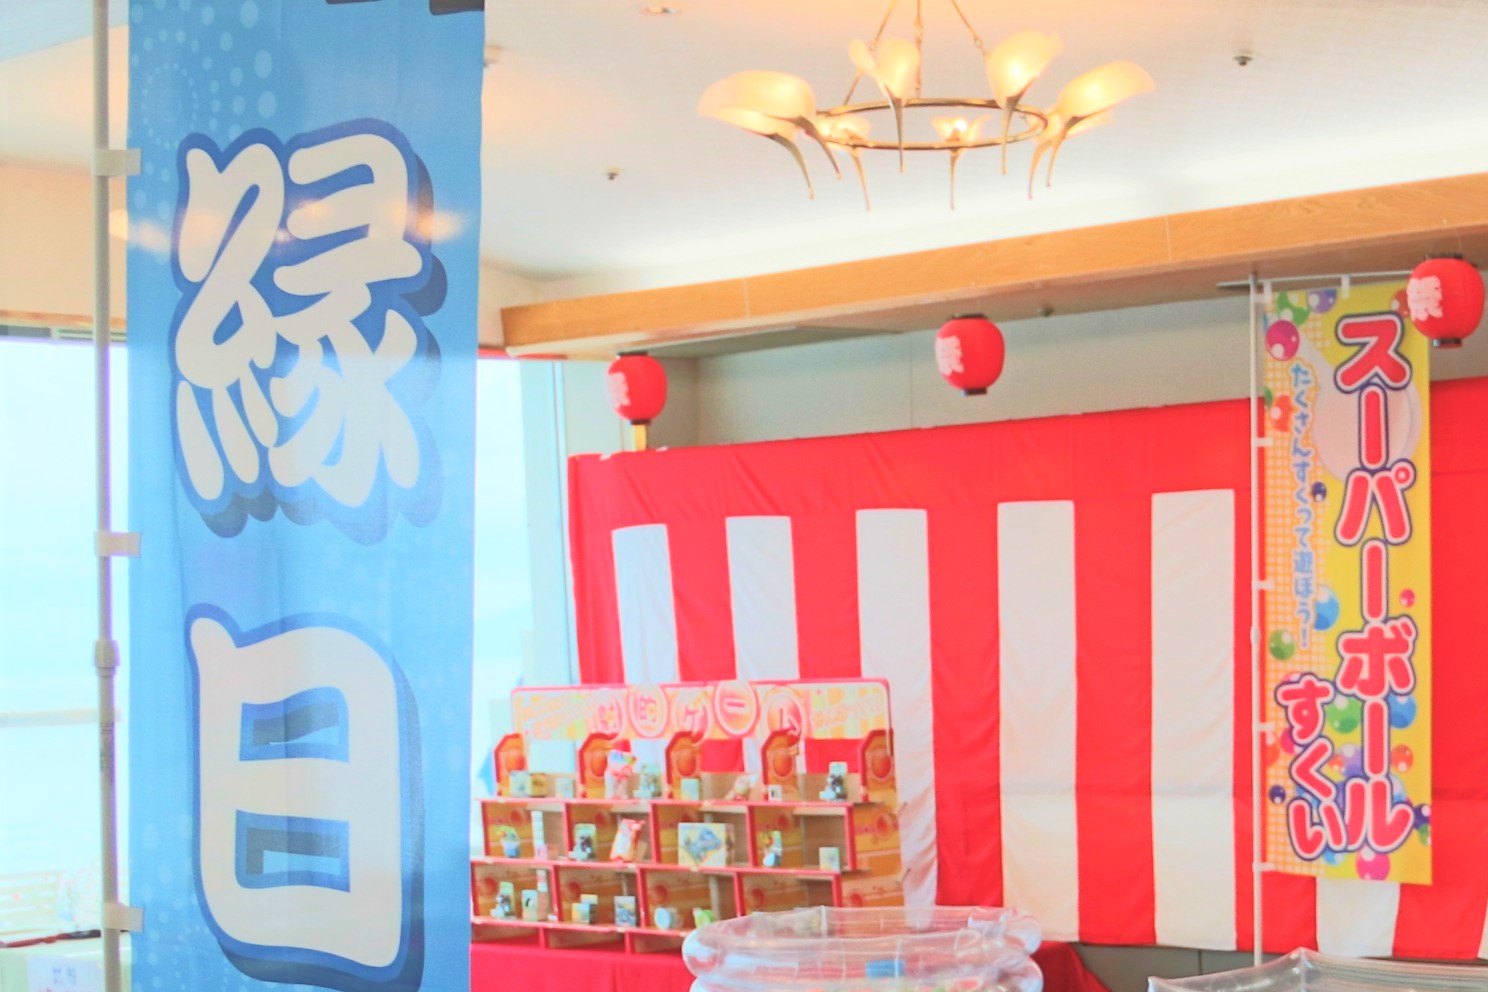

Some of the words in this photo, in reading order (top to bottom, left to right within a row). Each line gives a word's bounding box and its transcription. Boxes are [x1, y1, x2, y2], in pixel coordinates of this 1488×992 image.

[1335, 312, 1418, 853] スーパーボール
[1276, 674, 1347, 861] すくい
